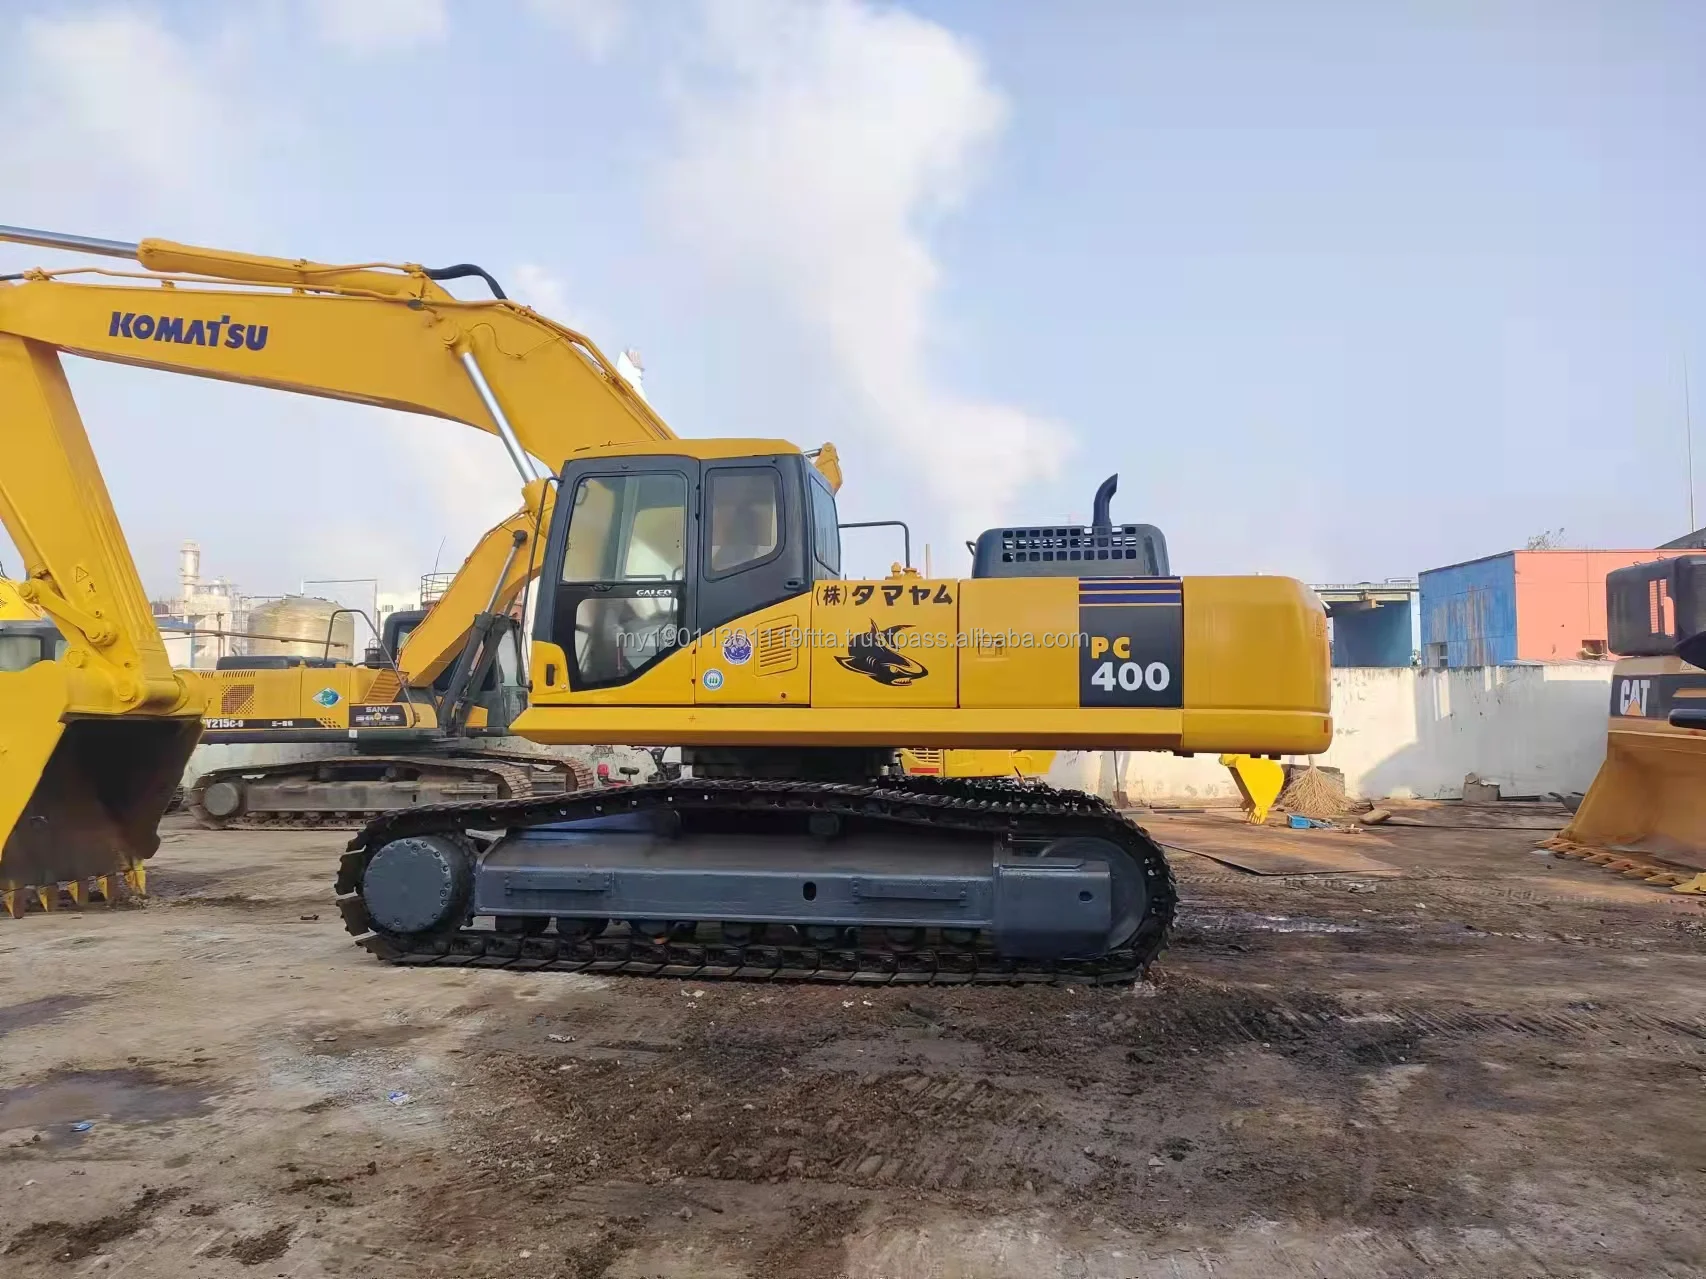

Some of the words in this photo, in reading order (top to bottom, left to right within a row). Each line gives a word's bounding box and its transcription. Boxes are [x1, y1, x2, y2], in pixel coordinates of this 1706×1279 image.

[109, 311, 268, 350] KOMATSU
[636, 589, 672, 597] GALEO
[1091, 636, 1131, 659] PC
[1091, 661, 1170, 692] 400
[1620, 679, 1651, 717] CAT
